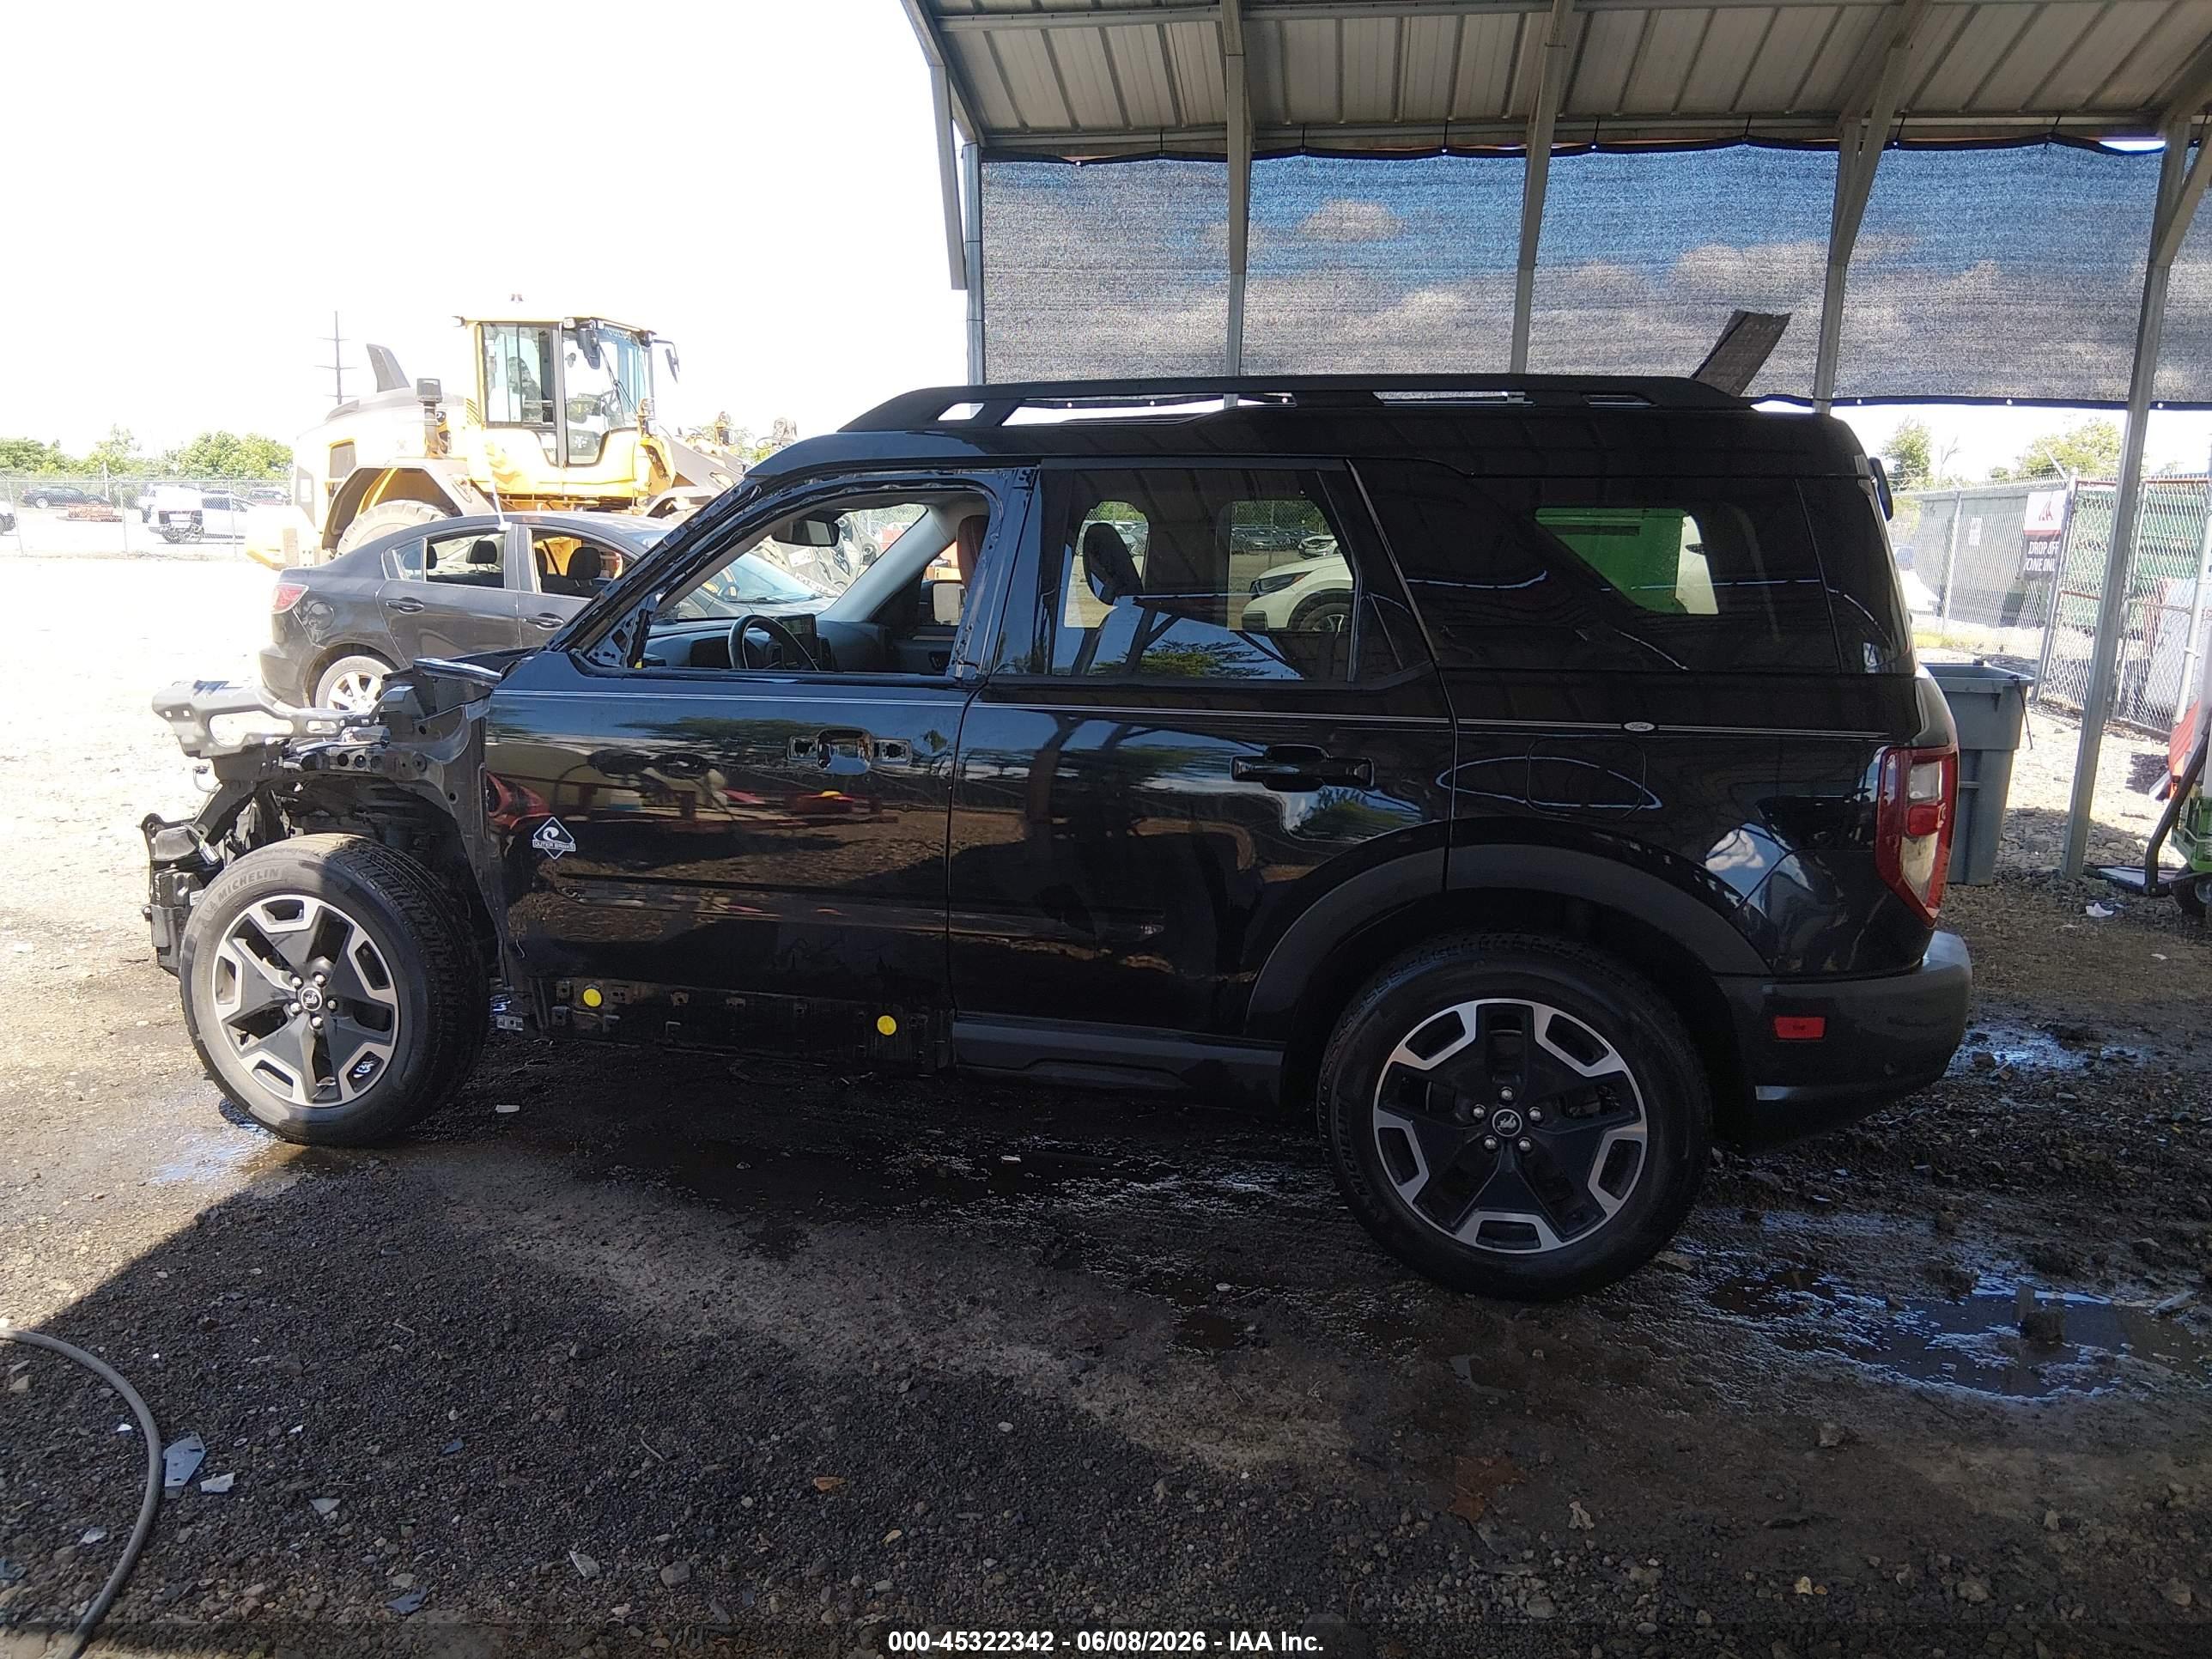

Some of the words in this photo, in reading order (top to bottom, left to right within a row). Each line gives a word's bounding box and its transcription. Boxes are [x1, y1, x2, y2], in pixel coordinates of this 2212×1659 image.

[2027, 541, 2048, 555] DROP
[2047, 541, 2060, 555] OFF
[217, 867, 279, 901] MICHELIN
